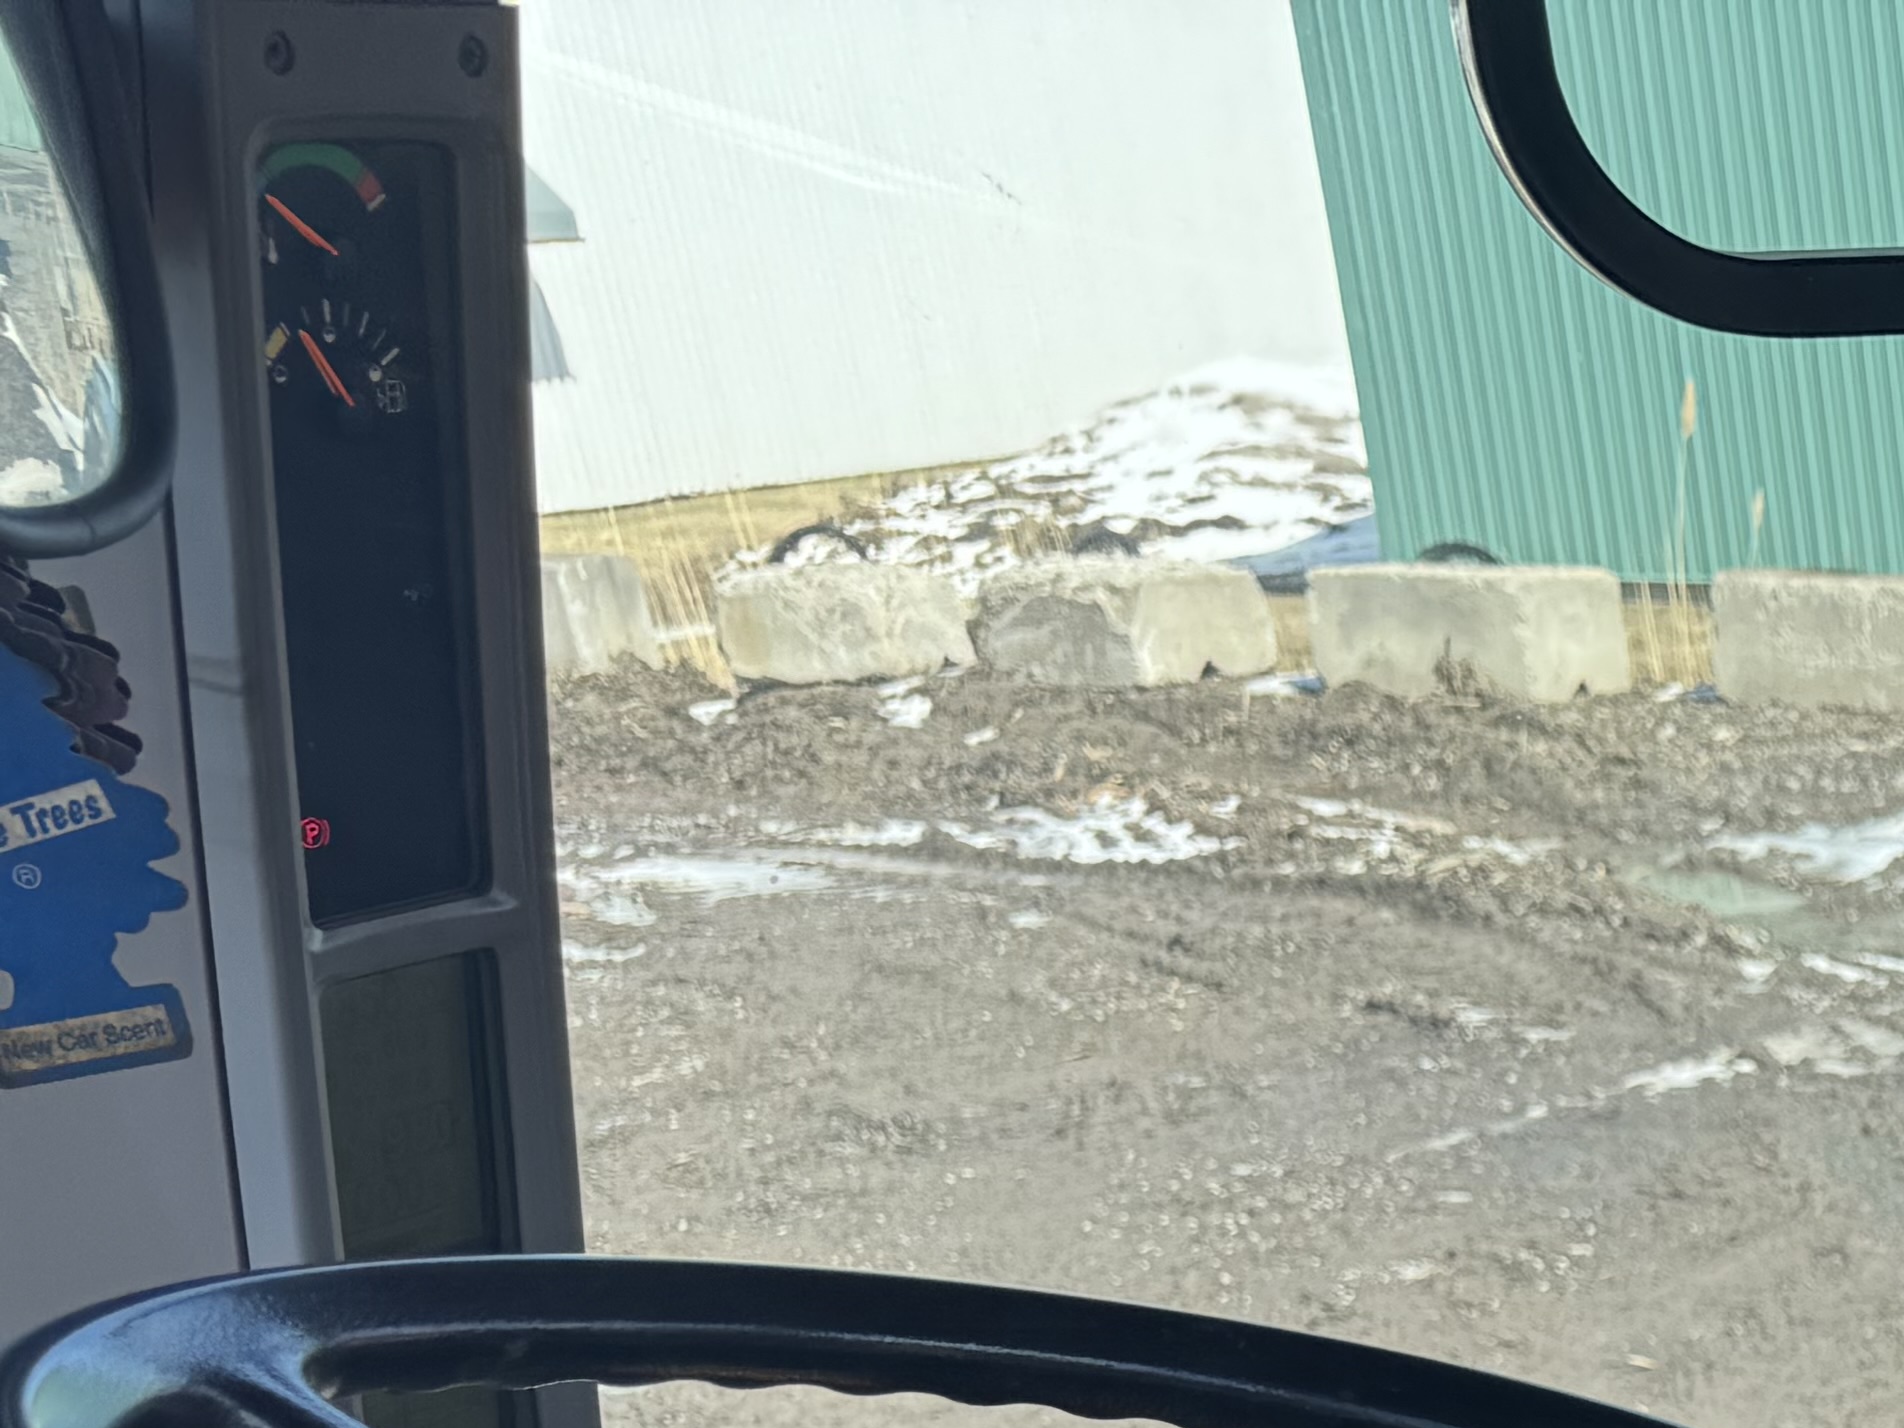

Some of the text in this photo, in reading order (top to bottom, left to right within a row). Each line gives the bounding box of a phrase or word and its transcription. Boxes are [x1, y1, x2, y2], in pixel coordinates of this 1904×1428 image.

[10, 794, 102, 838] Trees
[57, 1030, 99, 1051] Car
[103, 1017, 167, 1046] Scent
